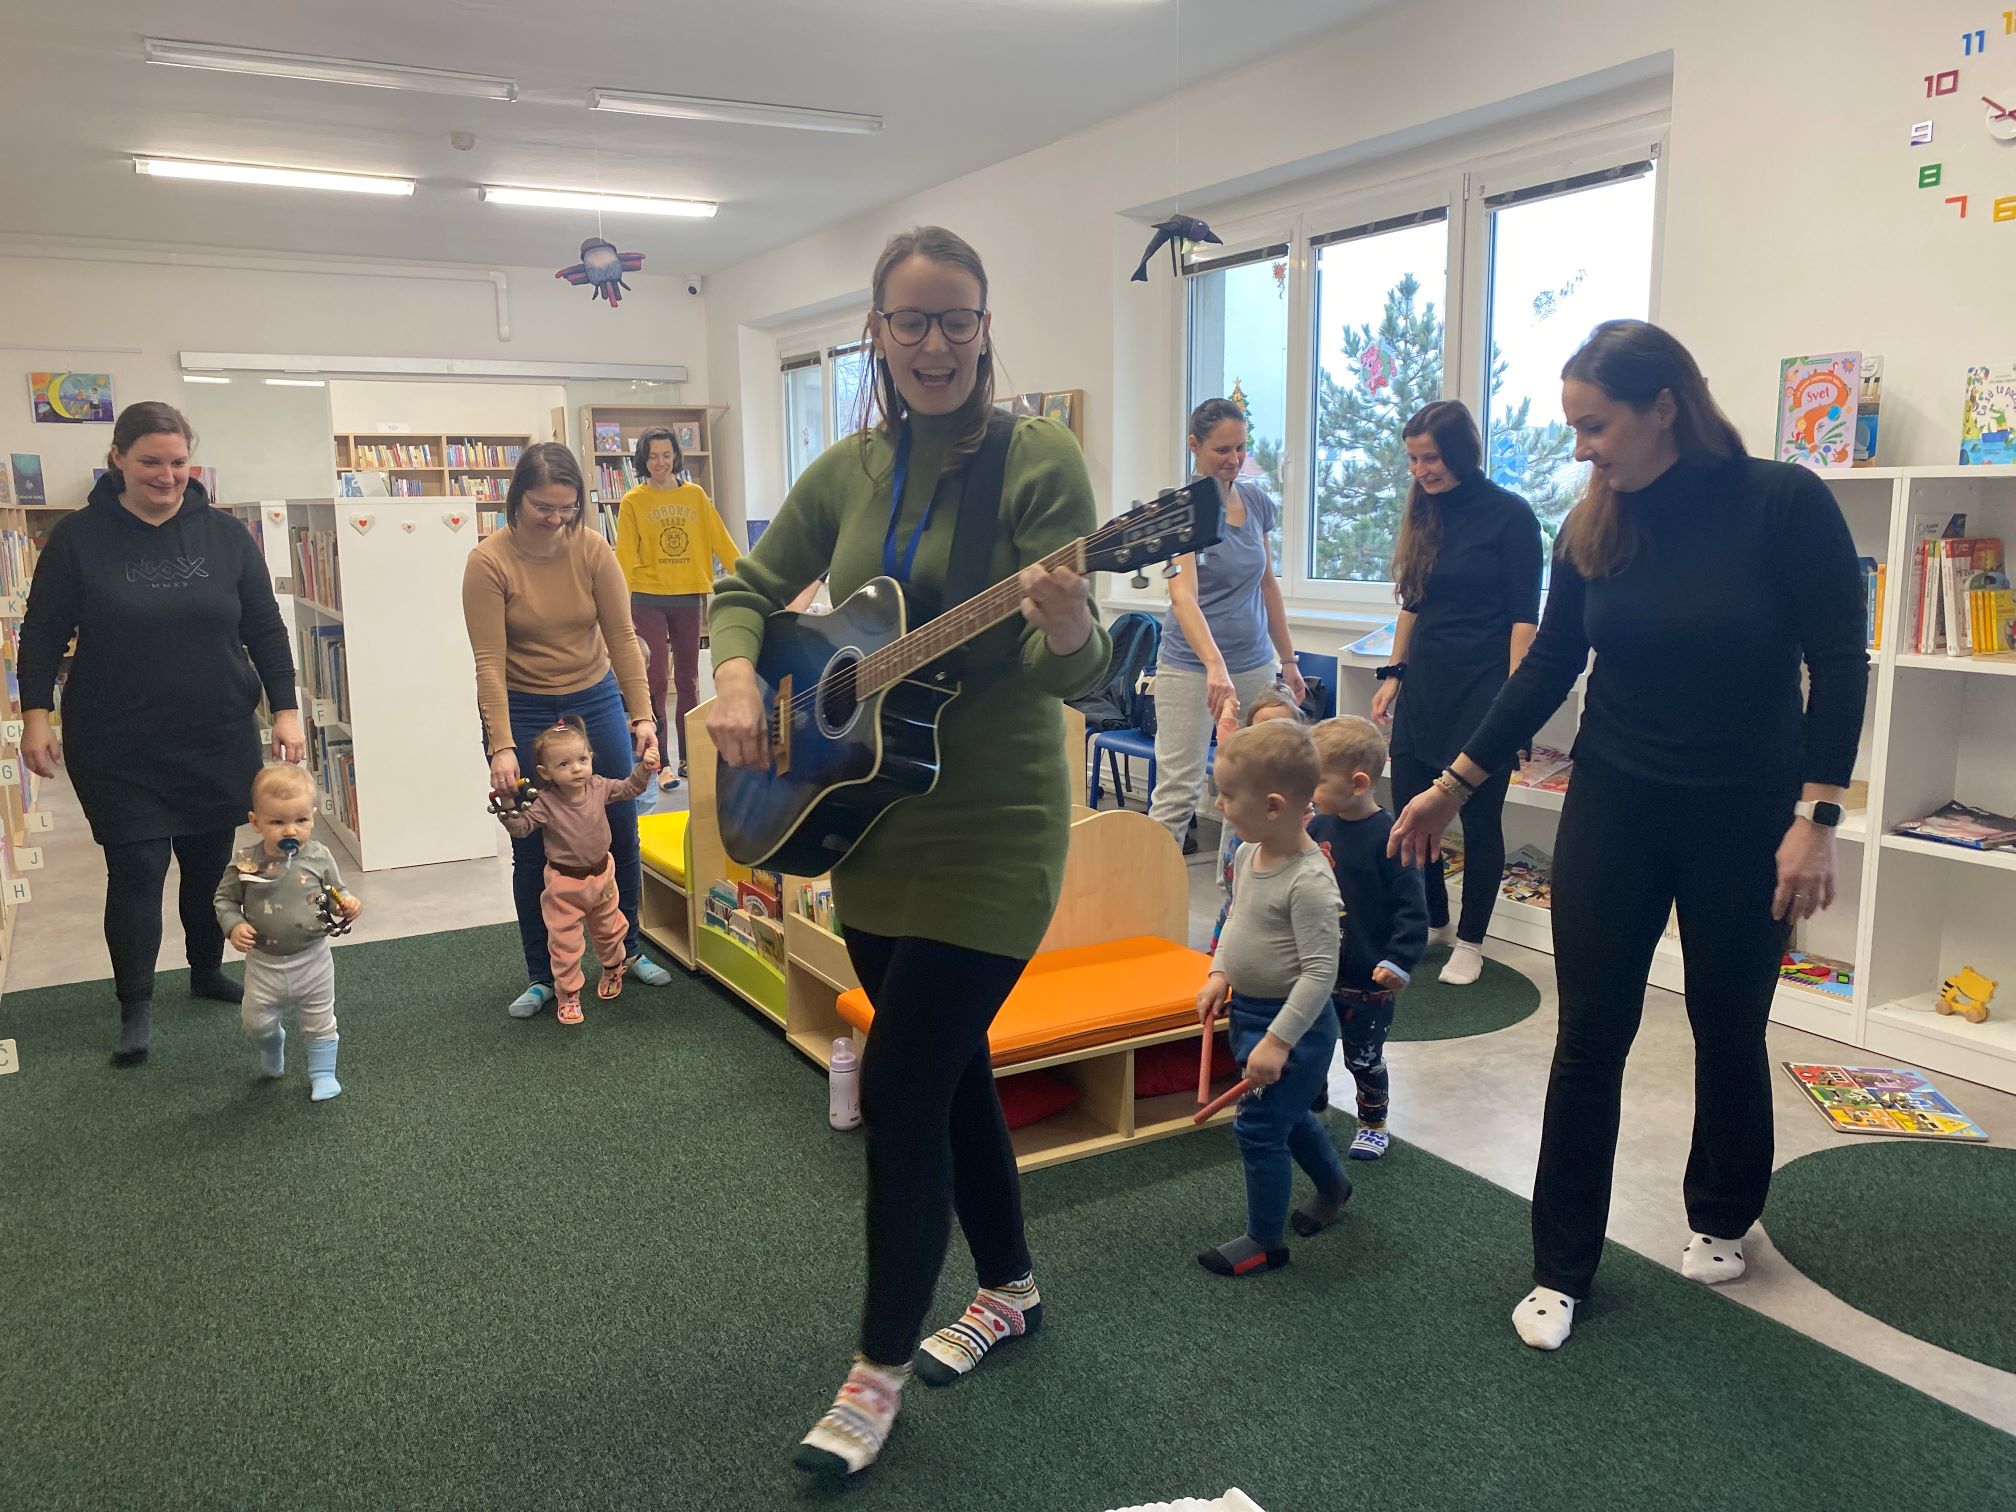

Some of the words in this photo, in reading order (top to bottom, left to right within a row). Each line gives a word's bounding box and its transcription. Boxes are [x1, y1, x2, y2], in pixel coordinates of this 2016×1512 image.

[2002, 11, 2016, 35] 1
[1962, 30, 1985, 56] 11
[1924, 69, 1959, 98] 10
[1910, 120, 1933, 146] 9
[1919, 163, 1942, 189] 8
[1945, 195, 1968, 219] 7
[1993, 195, 2016, 222] 6
[1807, 386, 1830, 402] Svet
[647, 505, 697, 521] TORONTO
[278, 581, 287, 592] A
[8, 600, 17, 613] K
[317, 709, 326, 722] F
[2, 764, 13, 780] G
[325, 799, 333, 811] G
[41, 815, 48, 827] L
[31, 851, 38, 865] J
[13, 883, 25, 899] H
